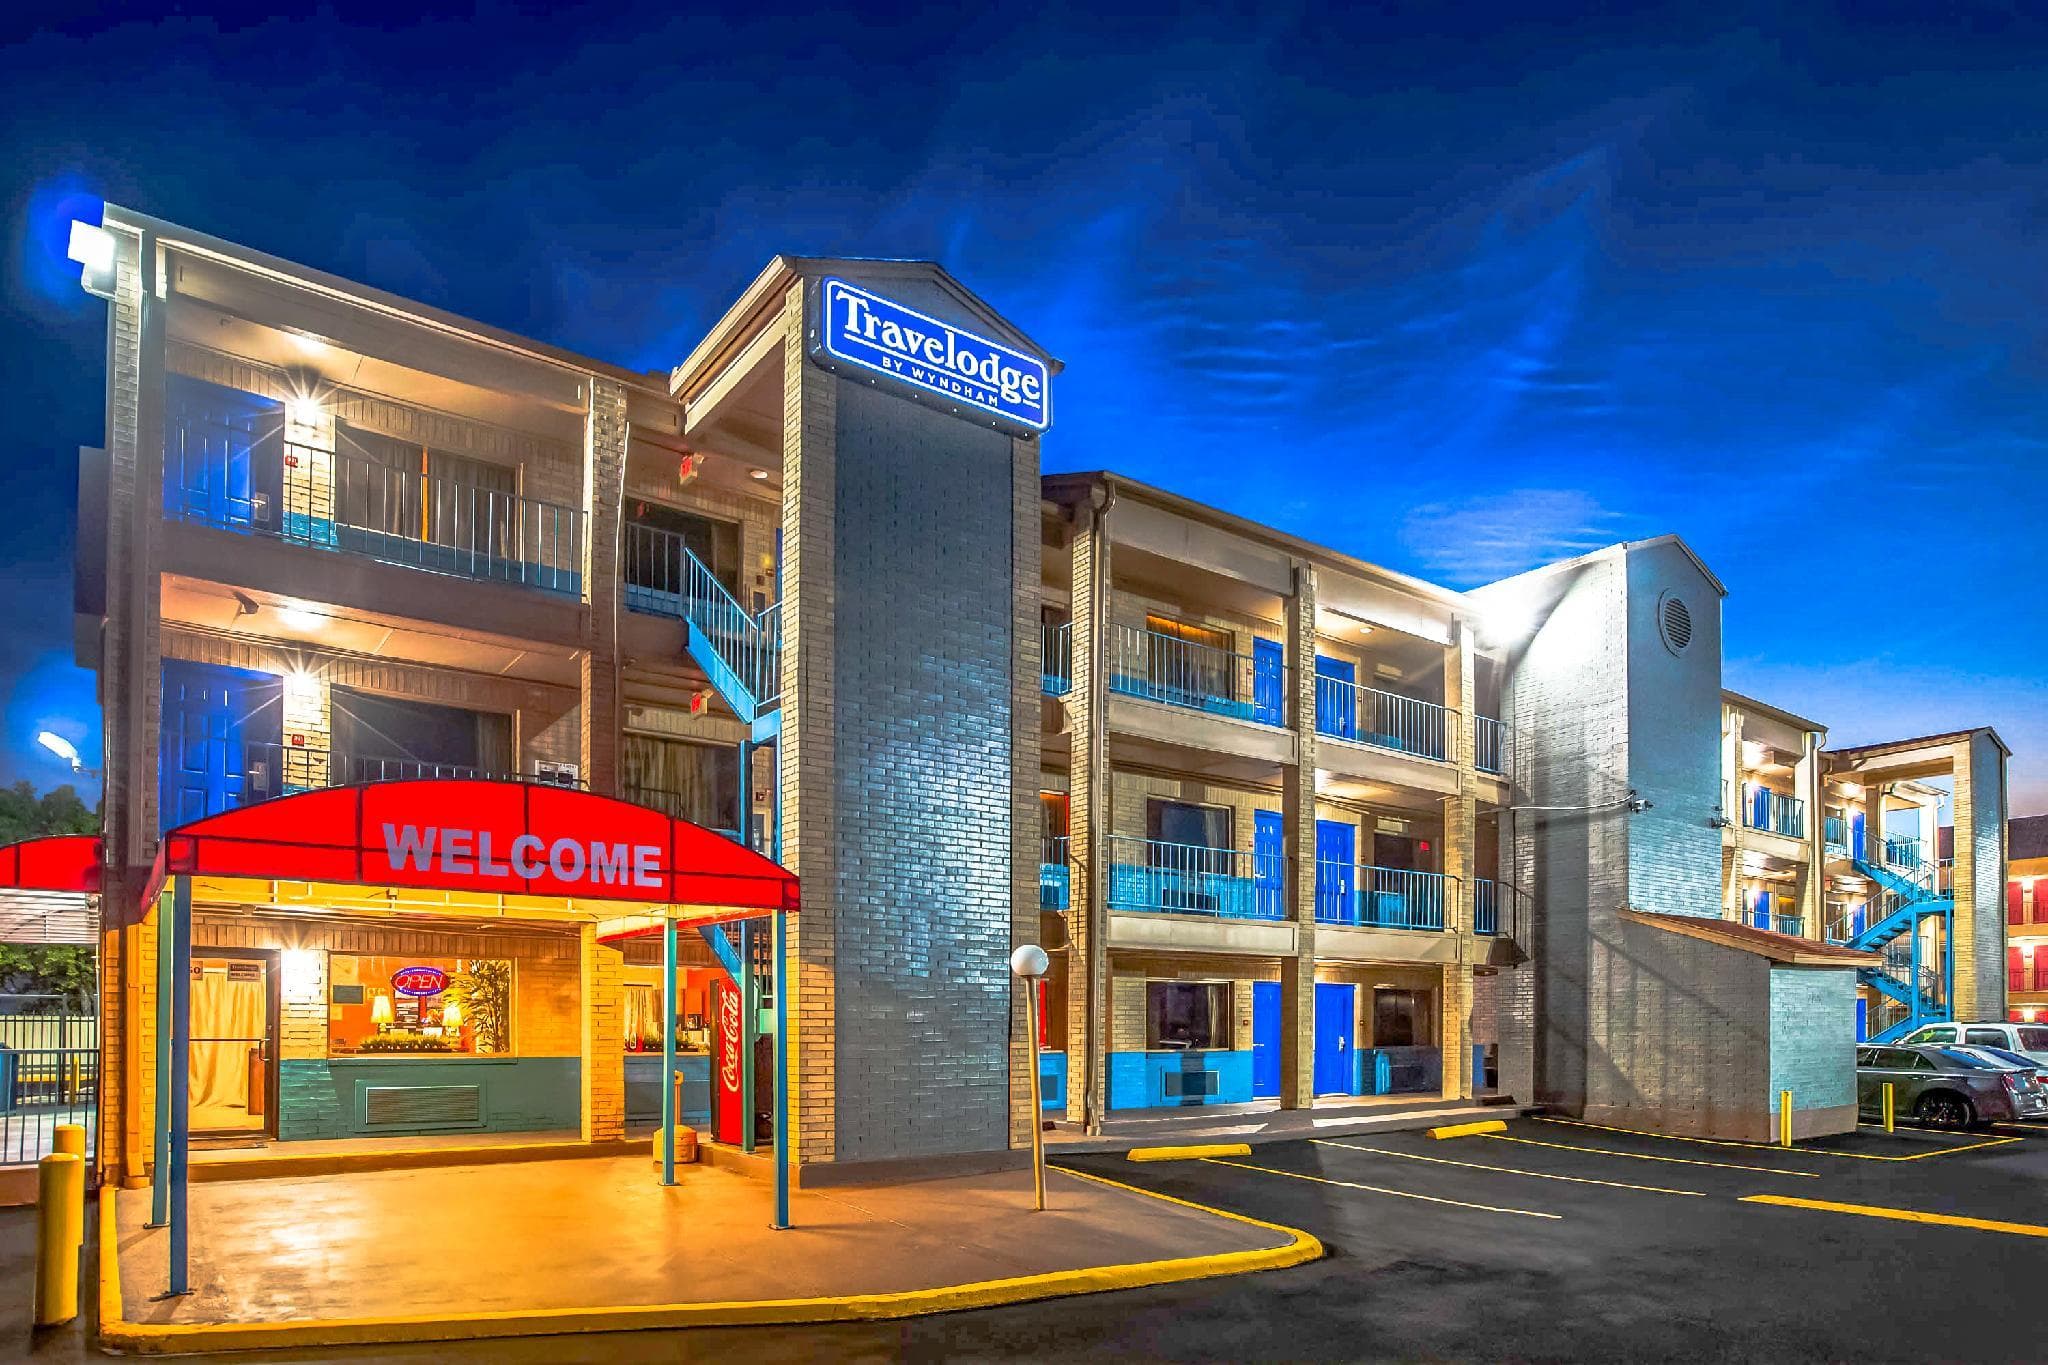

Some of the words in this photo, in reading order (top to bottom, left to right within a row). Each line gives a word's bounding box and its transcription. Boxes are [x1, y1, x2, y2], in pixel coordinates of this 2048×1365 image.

[835, 289, 1041, 405] Travelodge
[882, 355, 903, 372] BY
[911, 366, 998, 407] WYNDHAM
[382, 822, 663, 888] WELCOME
[394, 974, 443, 989] OPEN
